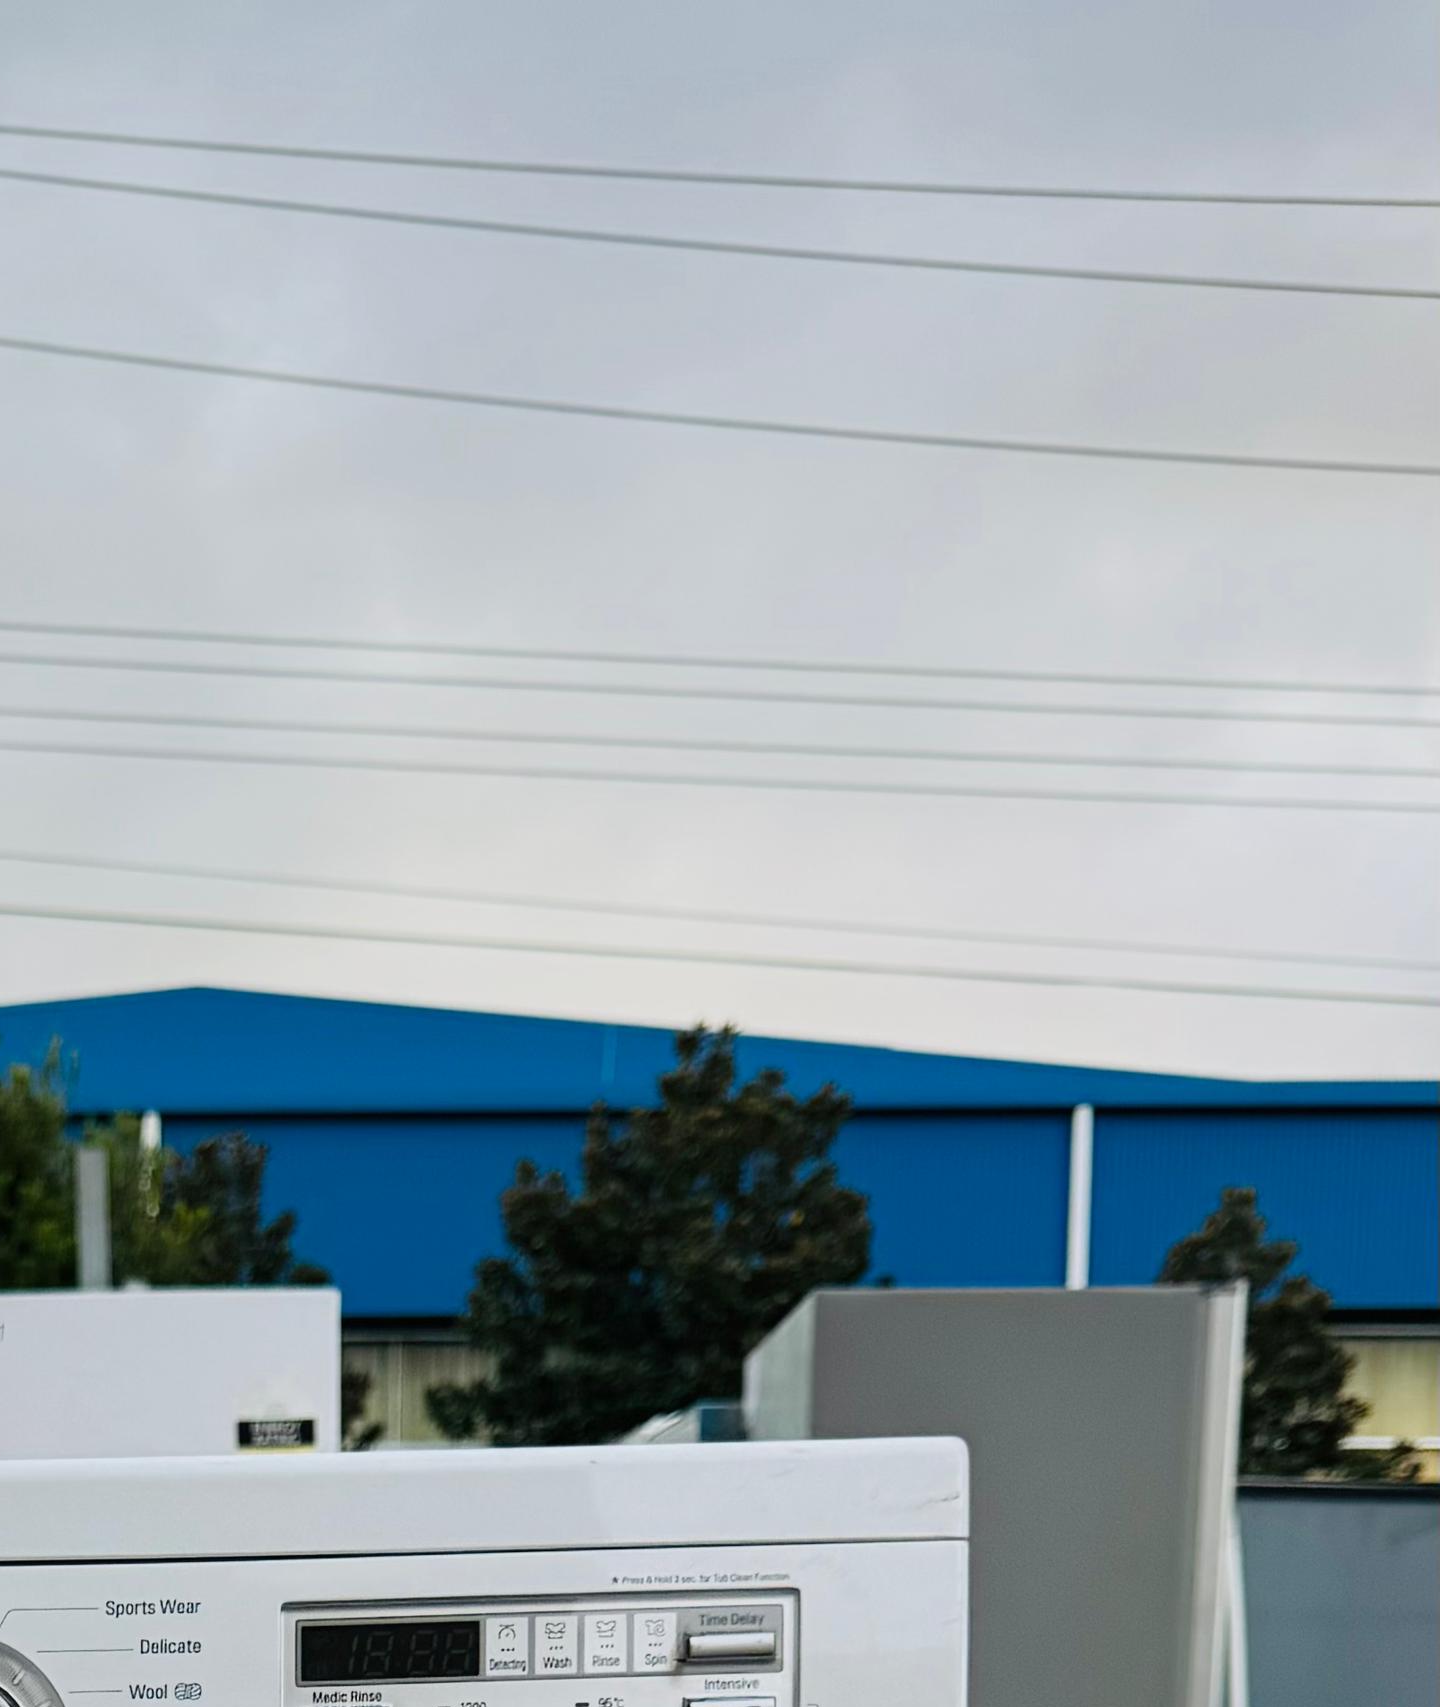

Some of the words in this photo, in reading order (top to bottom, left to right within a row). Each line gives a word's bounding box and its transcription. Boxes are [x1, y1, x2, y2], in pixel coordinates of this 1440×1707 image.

[104, 1599, 156, 1619] Sports
[159, 1599, 202, 1616] Wear
[699, 1613, 728, 1626] Time
[730, 1611, 764, 1627] Delay
[139, 1637, 202, 1655] Delicate
[489, 1658, 527, 1673] Detecting
[543, 1656, 573, 1669] Wash
[592, 1655, 621, 1667] Rinse
[644, 1653, 667, 1667] Spin
[703, 1678, 760, 1691] Intensive
[129, 1684, 169, 1700] Wool
[312, 1691, 347, 1703] Medic
[350, 1690, 382, 1703] Rinse
